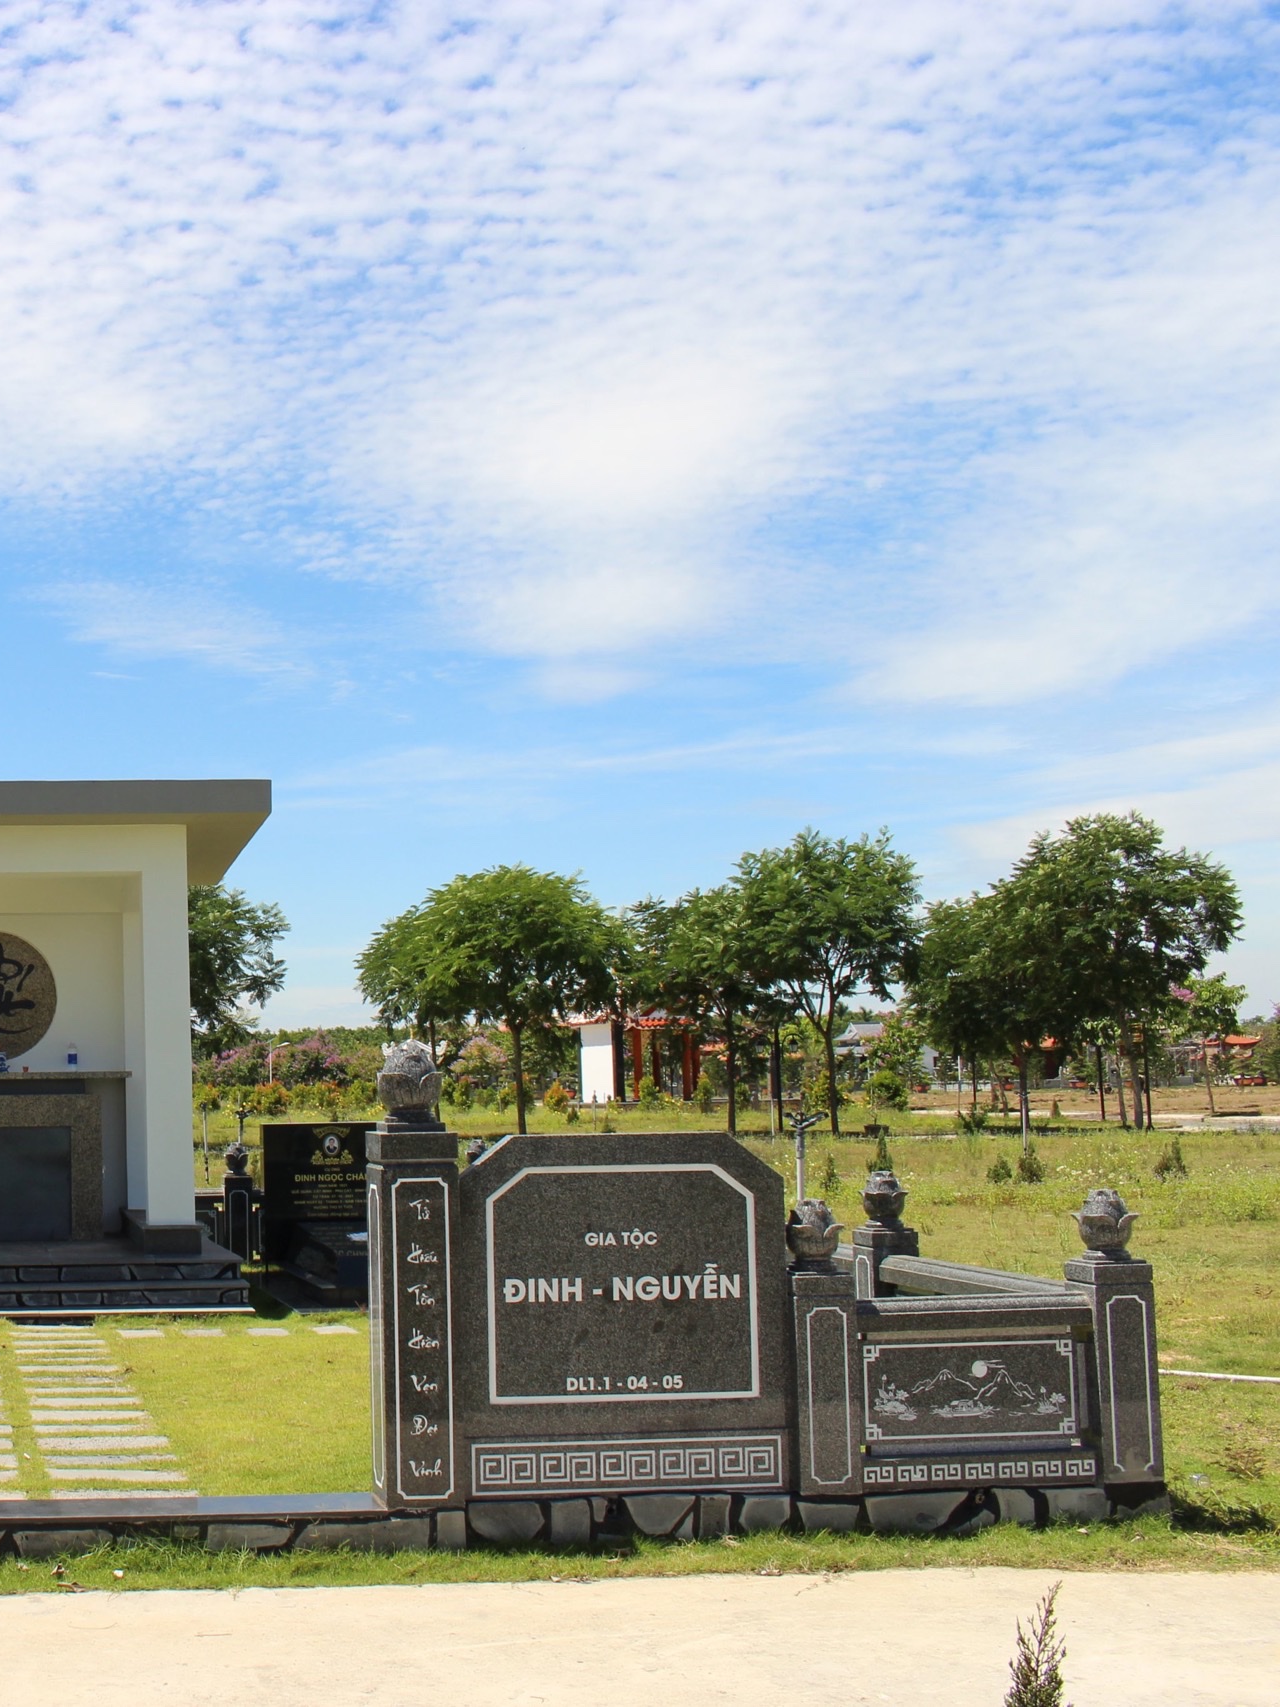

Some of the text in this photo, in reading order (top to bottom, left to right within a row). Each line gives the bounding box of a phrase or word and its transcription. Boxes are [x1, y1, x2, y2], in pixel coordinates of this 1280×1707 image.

[294, 1174, 316, 1182] ĐINH
[318, 1173, 343, 1182] NGỌC
[584, 1227, 658, 1250] GIA TỘC
[503, 1277, 583, 1303] ĐINH
[612, 1263, 741, 1302] NGUYỄN
[566, 1376, 609, 1391] DL1.1
[626, 1376, 649, 1390] 04
[662, 1374, 684, 1389] 05
